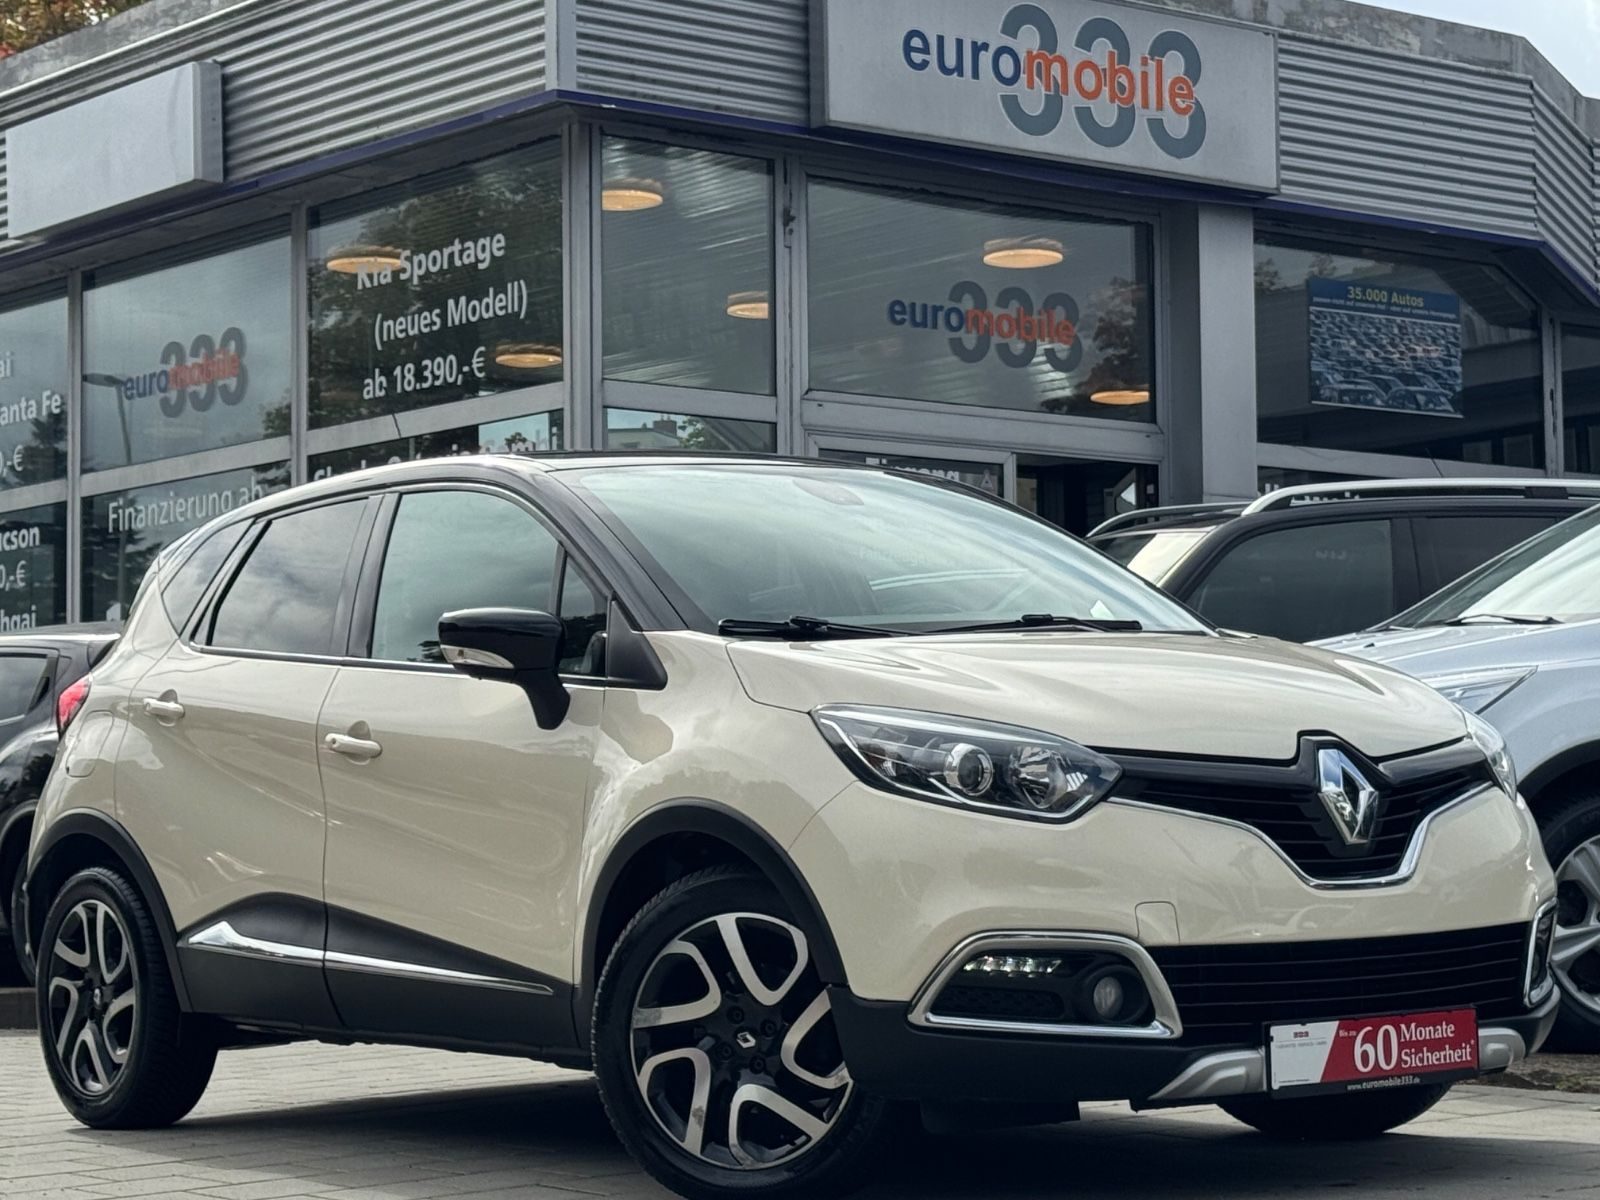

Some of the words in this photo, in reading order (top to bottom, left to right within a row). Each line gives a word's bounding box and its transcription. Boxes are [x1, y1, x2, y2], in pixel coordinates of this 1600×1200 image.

[902, 28, 1195, 117] euromobile
[999, 2, 1207, 160] 333
[400, 233, 506, 286] Sportage
[374, 308, 441, 351] (neues
[447, 279, 528, 328] Modell)
[887, 298, 1077, 346] euromobile
[1347, 286, 1388, 303] 35.000
[1391, 291, 1425, 307] Autos
[947, 280, 1084, 373] 333
[122, 347, 241, 401] euromobile
[159, 326, 249, 419] 333
[363, 367, 387, 400] ab
[393, 346, 487, 394] 18.390,-€
[42, 389, 61, 416] Fe
[108, 490, 232, 534] Finanzierung
[0, 526, 40, 552] cson
[1354, 1024, 1398, 1073] 60
[1400, 1020, 1455, 1043] Monate
